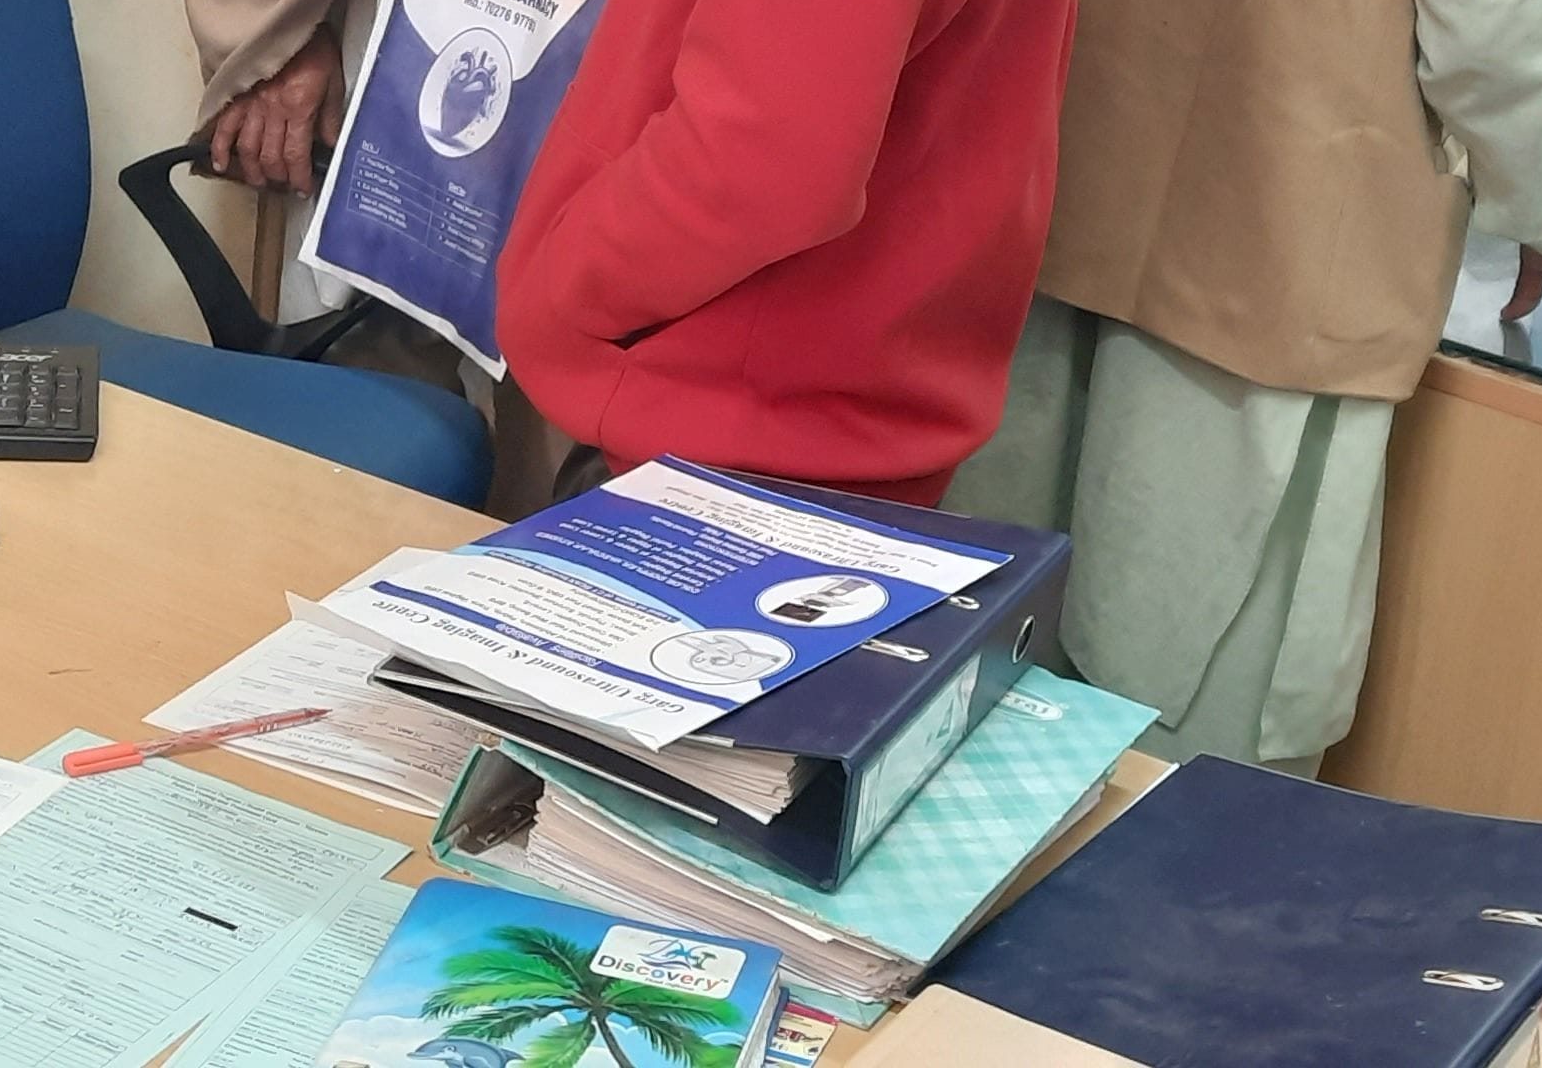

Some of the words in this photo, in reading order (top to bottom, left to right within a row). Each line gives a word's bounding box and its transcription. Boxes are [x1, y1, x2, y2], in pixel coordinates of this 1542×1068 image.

[368, 599, 433, 625] Centre
[427, 618, 508, 652] Imaging
[523, 656, 633, 697] Ultrasound
[631, 691, 687, 714] Garg
[598, 955, 721, 992] Discovery
